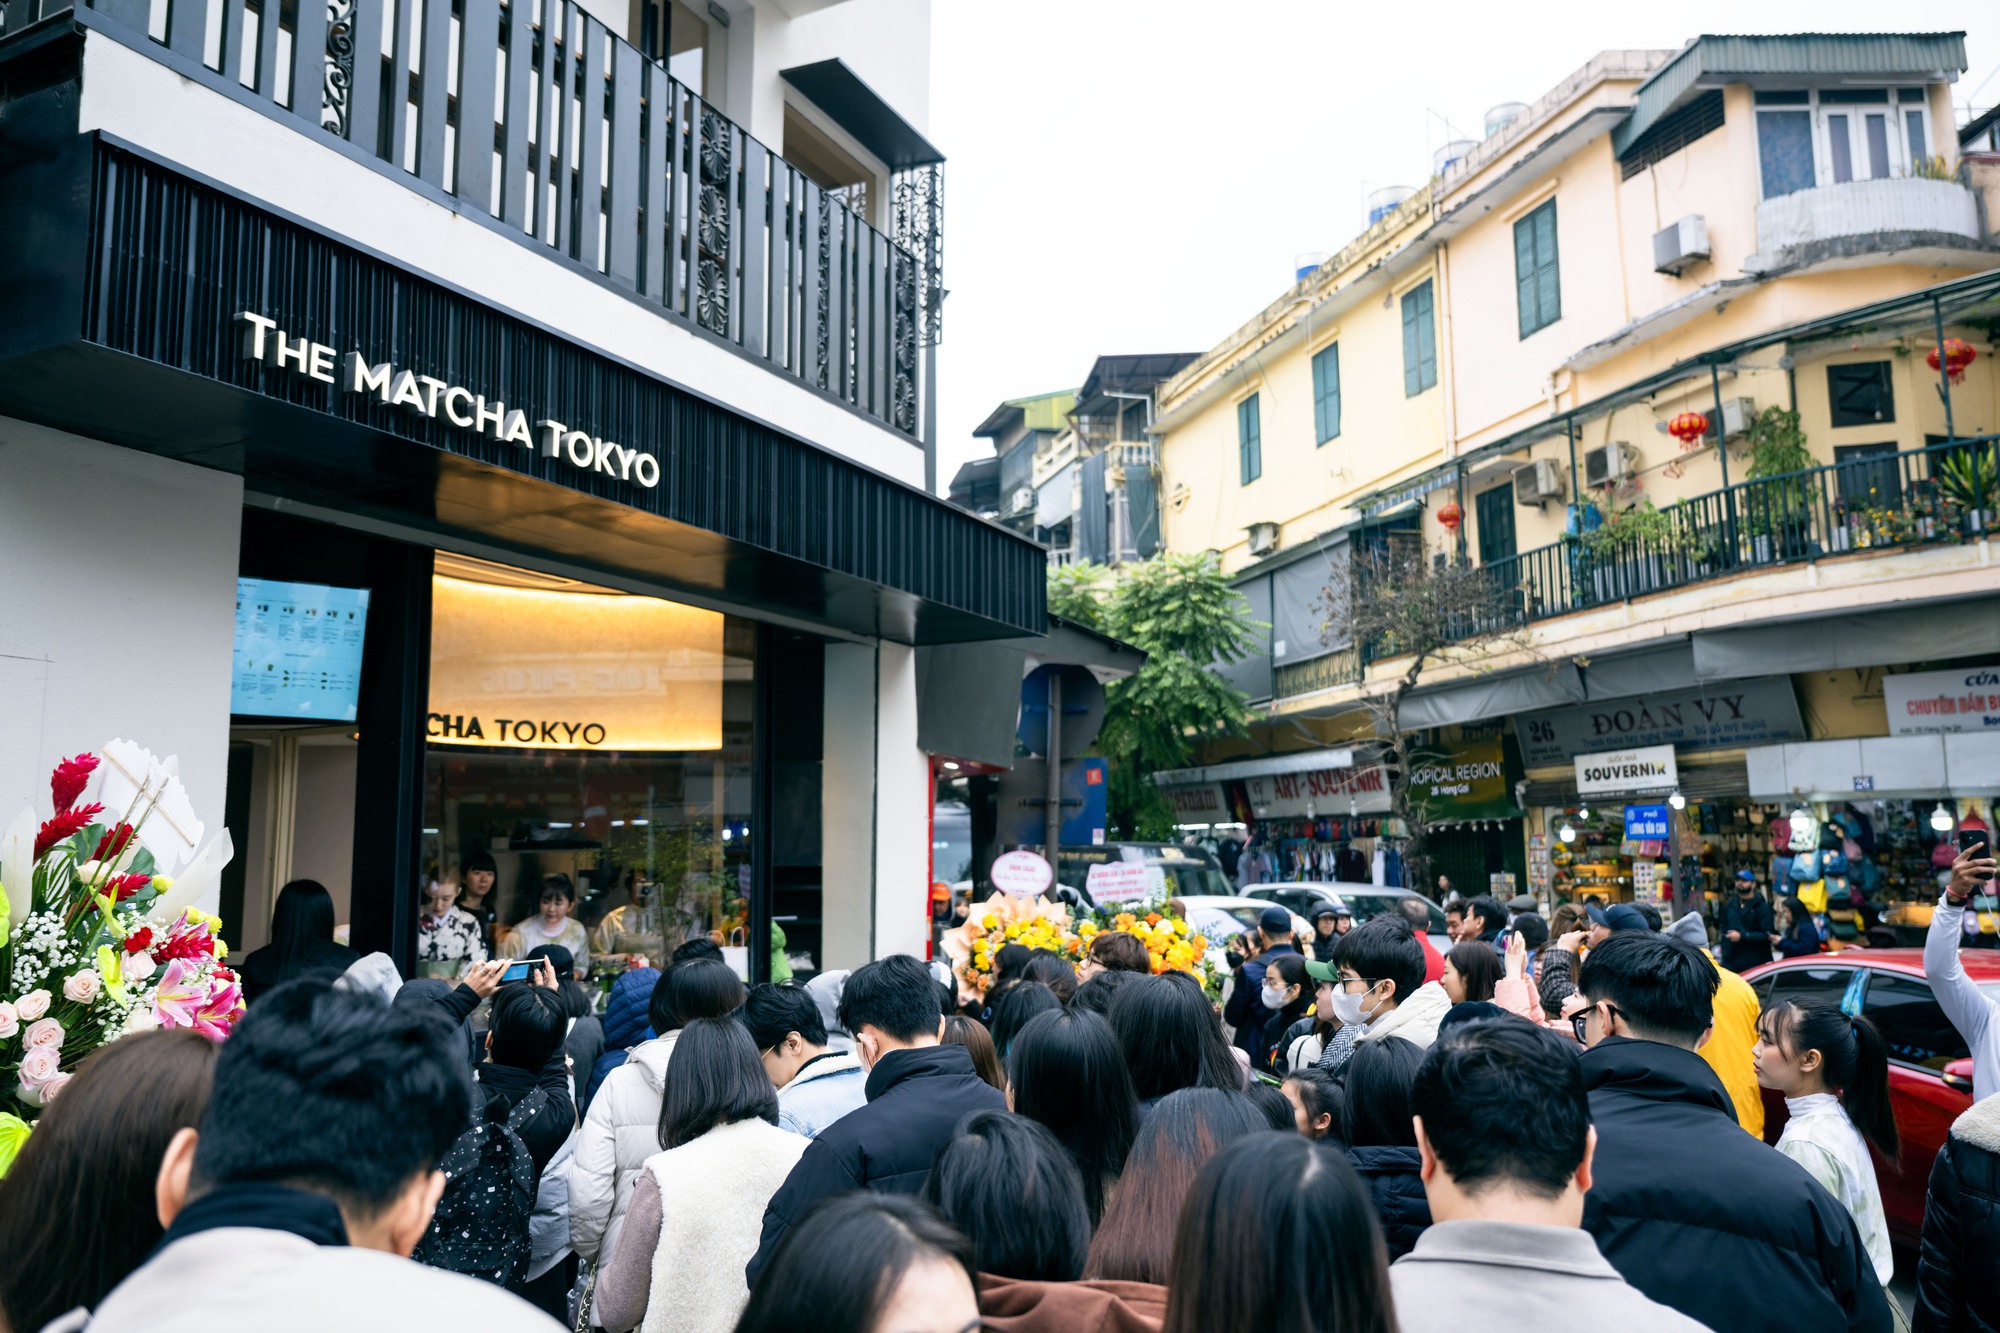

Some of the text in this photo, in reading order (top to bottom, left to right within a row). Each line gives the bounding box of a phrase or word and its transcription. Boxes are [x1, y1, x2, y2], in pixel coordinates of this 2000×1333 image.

[237, 311, 660, 488] THE MATCHA TOKYO
[426, 713, 606, 745] CHA TOKYO
[1590, 694, 1745, 736] ĐOÀN VY
[1529, 720, 1555, 743] 26
[1273, 773, 1299, 799] ART
[1307, 765, 1384, 798] SOUVENIR
[1410, 761, 1500, 785] ROPICAL REGION
[1584, 761, 1666, 782] SOUVERNIR
